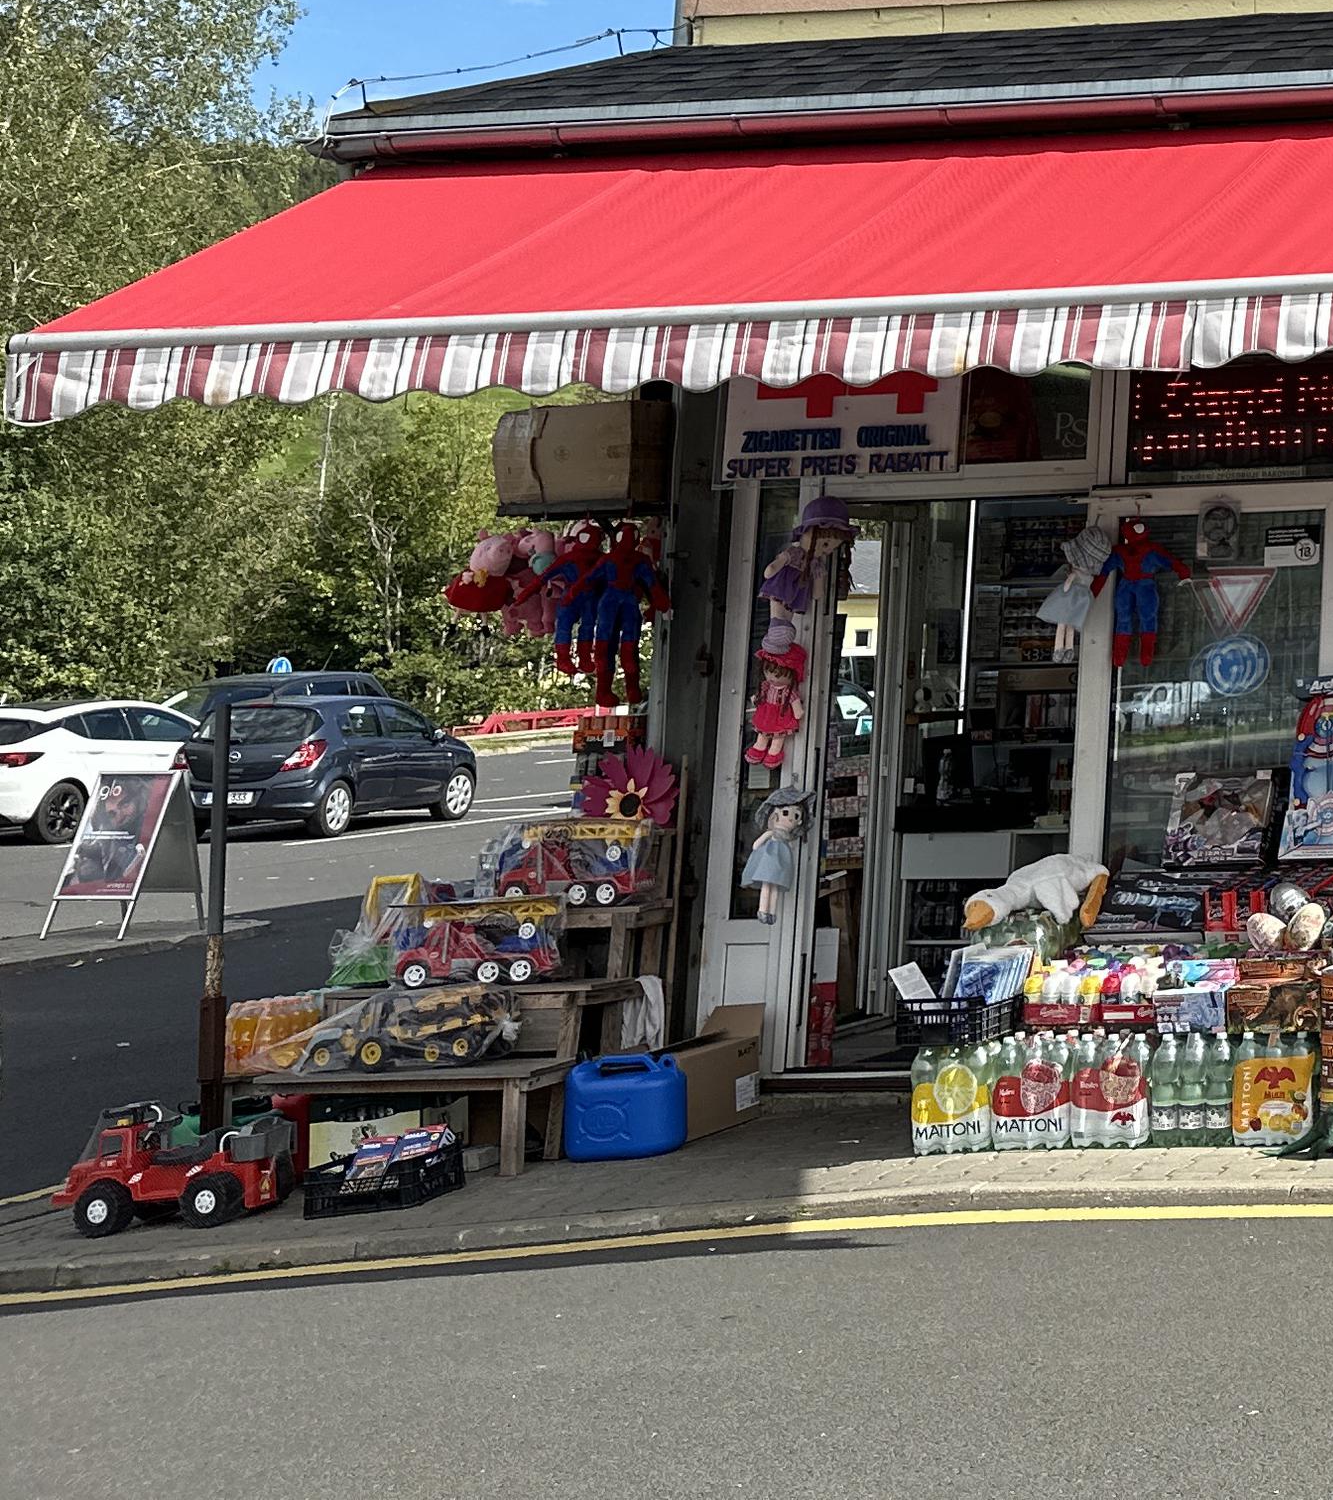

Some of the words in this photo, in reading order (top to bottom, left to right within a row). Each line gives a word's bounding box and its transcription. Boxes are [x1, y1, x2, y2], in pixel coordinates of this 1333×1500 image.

[741, 427, 842, 453] ZIGARETTEN
[856, 424, 931, 448] ORIGINAL
[726, 457, 791, 479] SUPER
[800, 453, 857, 477] PREIS
[869, 450, 949, 473] RABATT
[1298, 546, 1311, 557] 18
[100, 779, 122, 800] glo
[1241, 1066, 1251, 1127] MATTONI
[915, 1120, 981, 1141] MATTONI
[995, 1118, 1062, 1134] MATTONI
